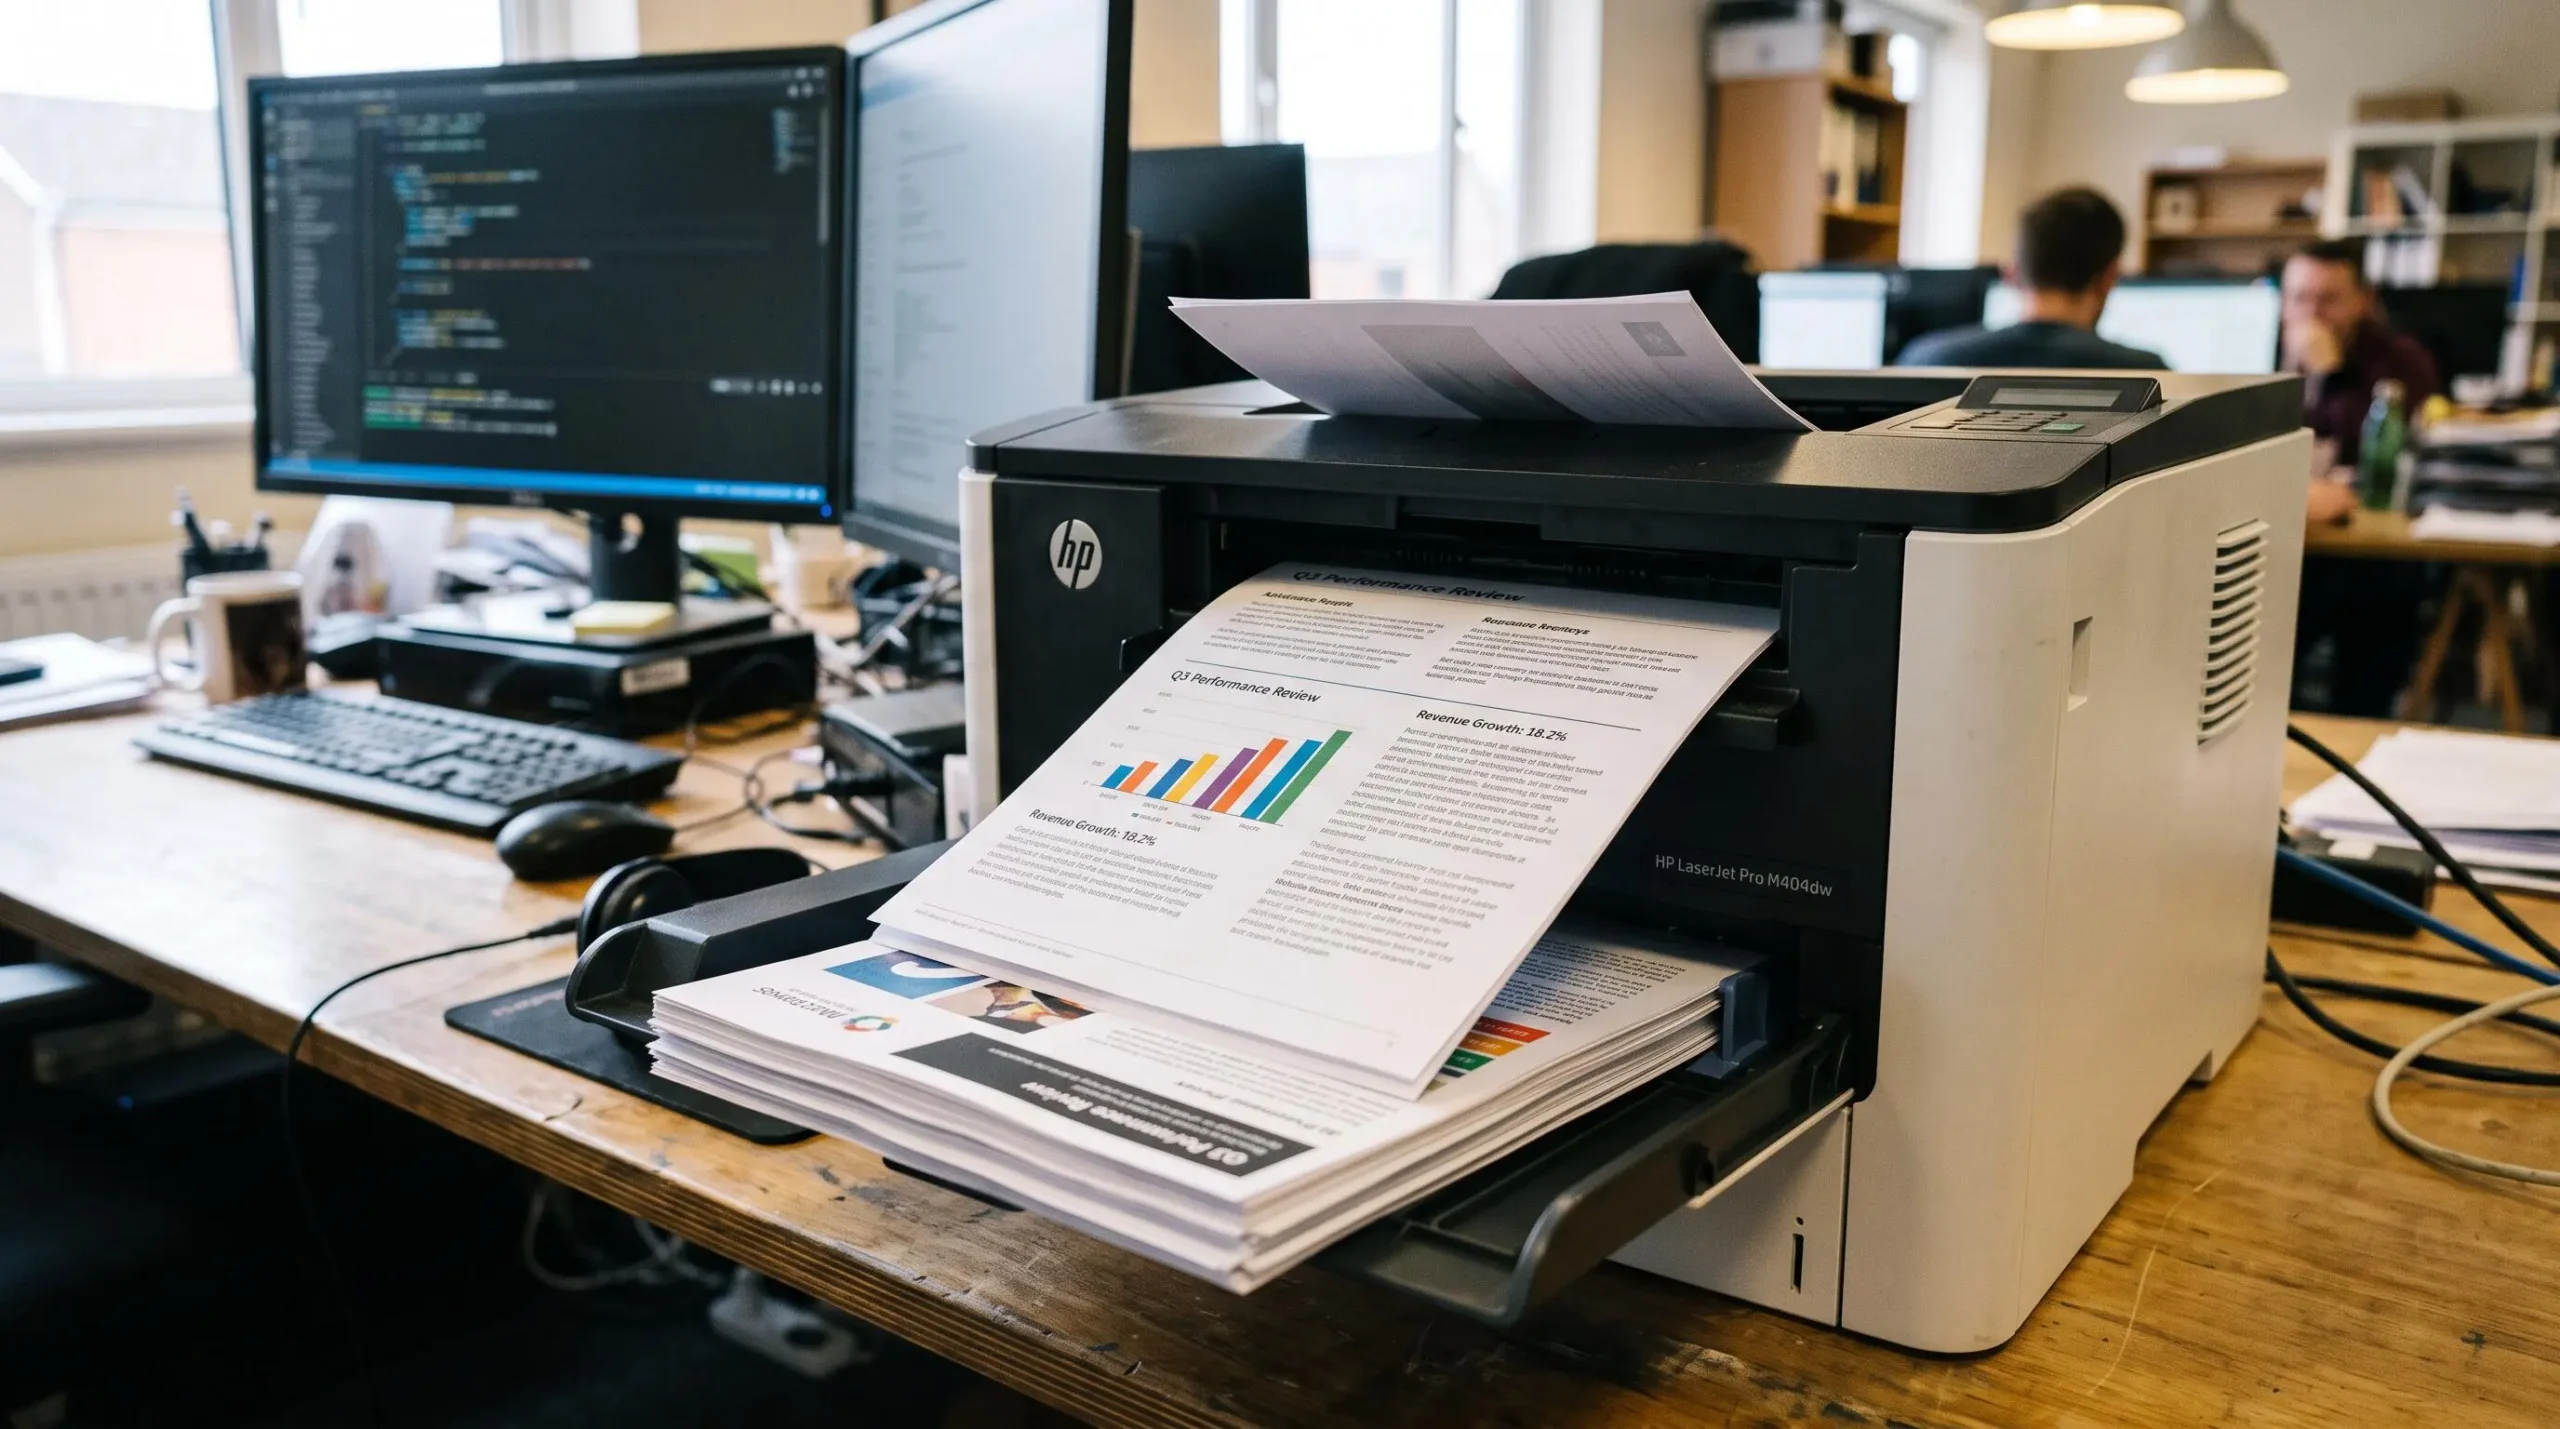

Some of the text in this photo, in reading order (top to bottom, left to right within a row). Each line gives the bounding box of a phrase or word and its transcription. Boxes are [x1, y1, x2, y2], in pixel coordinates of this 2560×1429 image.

[1057, 519, 1095, 590] hp
[1322, 573, 1446, 594] Performance
[1449, 586, 1525, 602] Review
[1171, 670, 1191, 681] Q3
[1191, 672, 1271, 695] Performance
[1272, 686, 1321, 703] Review
[1416, 709, 1568, 742] Revenue Growth: 18.2%
[1075, 820, 1120, 838] Growth:
[1121, 831, 1157, 846] 18.2%
[1655, 854, 1833, 897] HP LaserJet Pro M404dw
